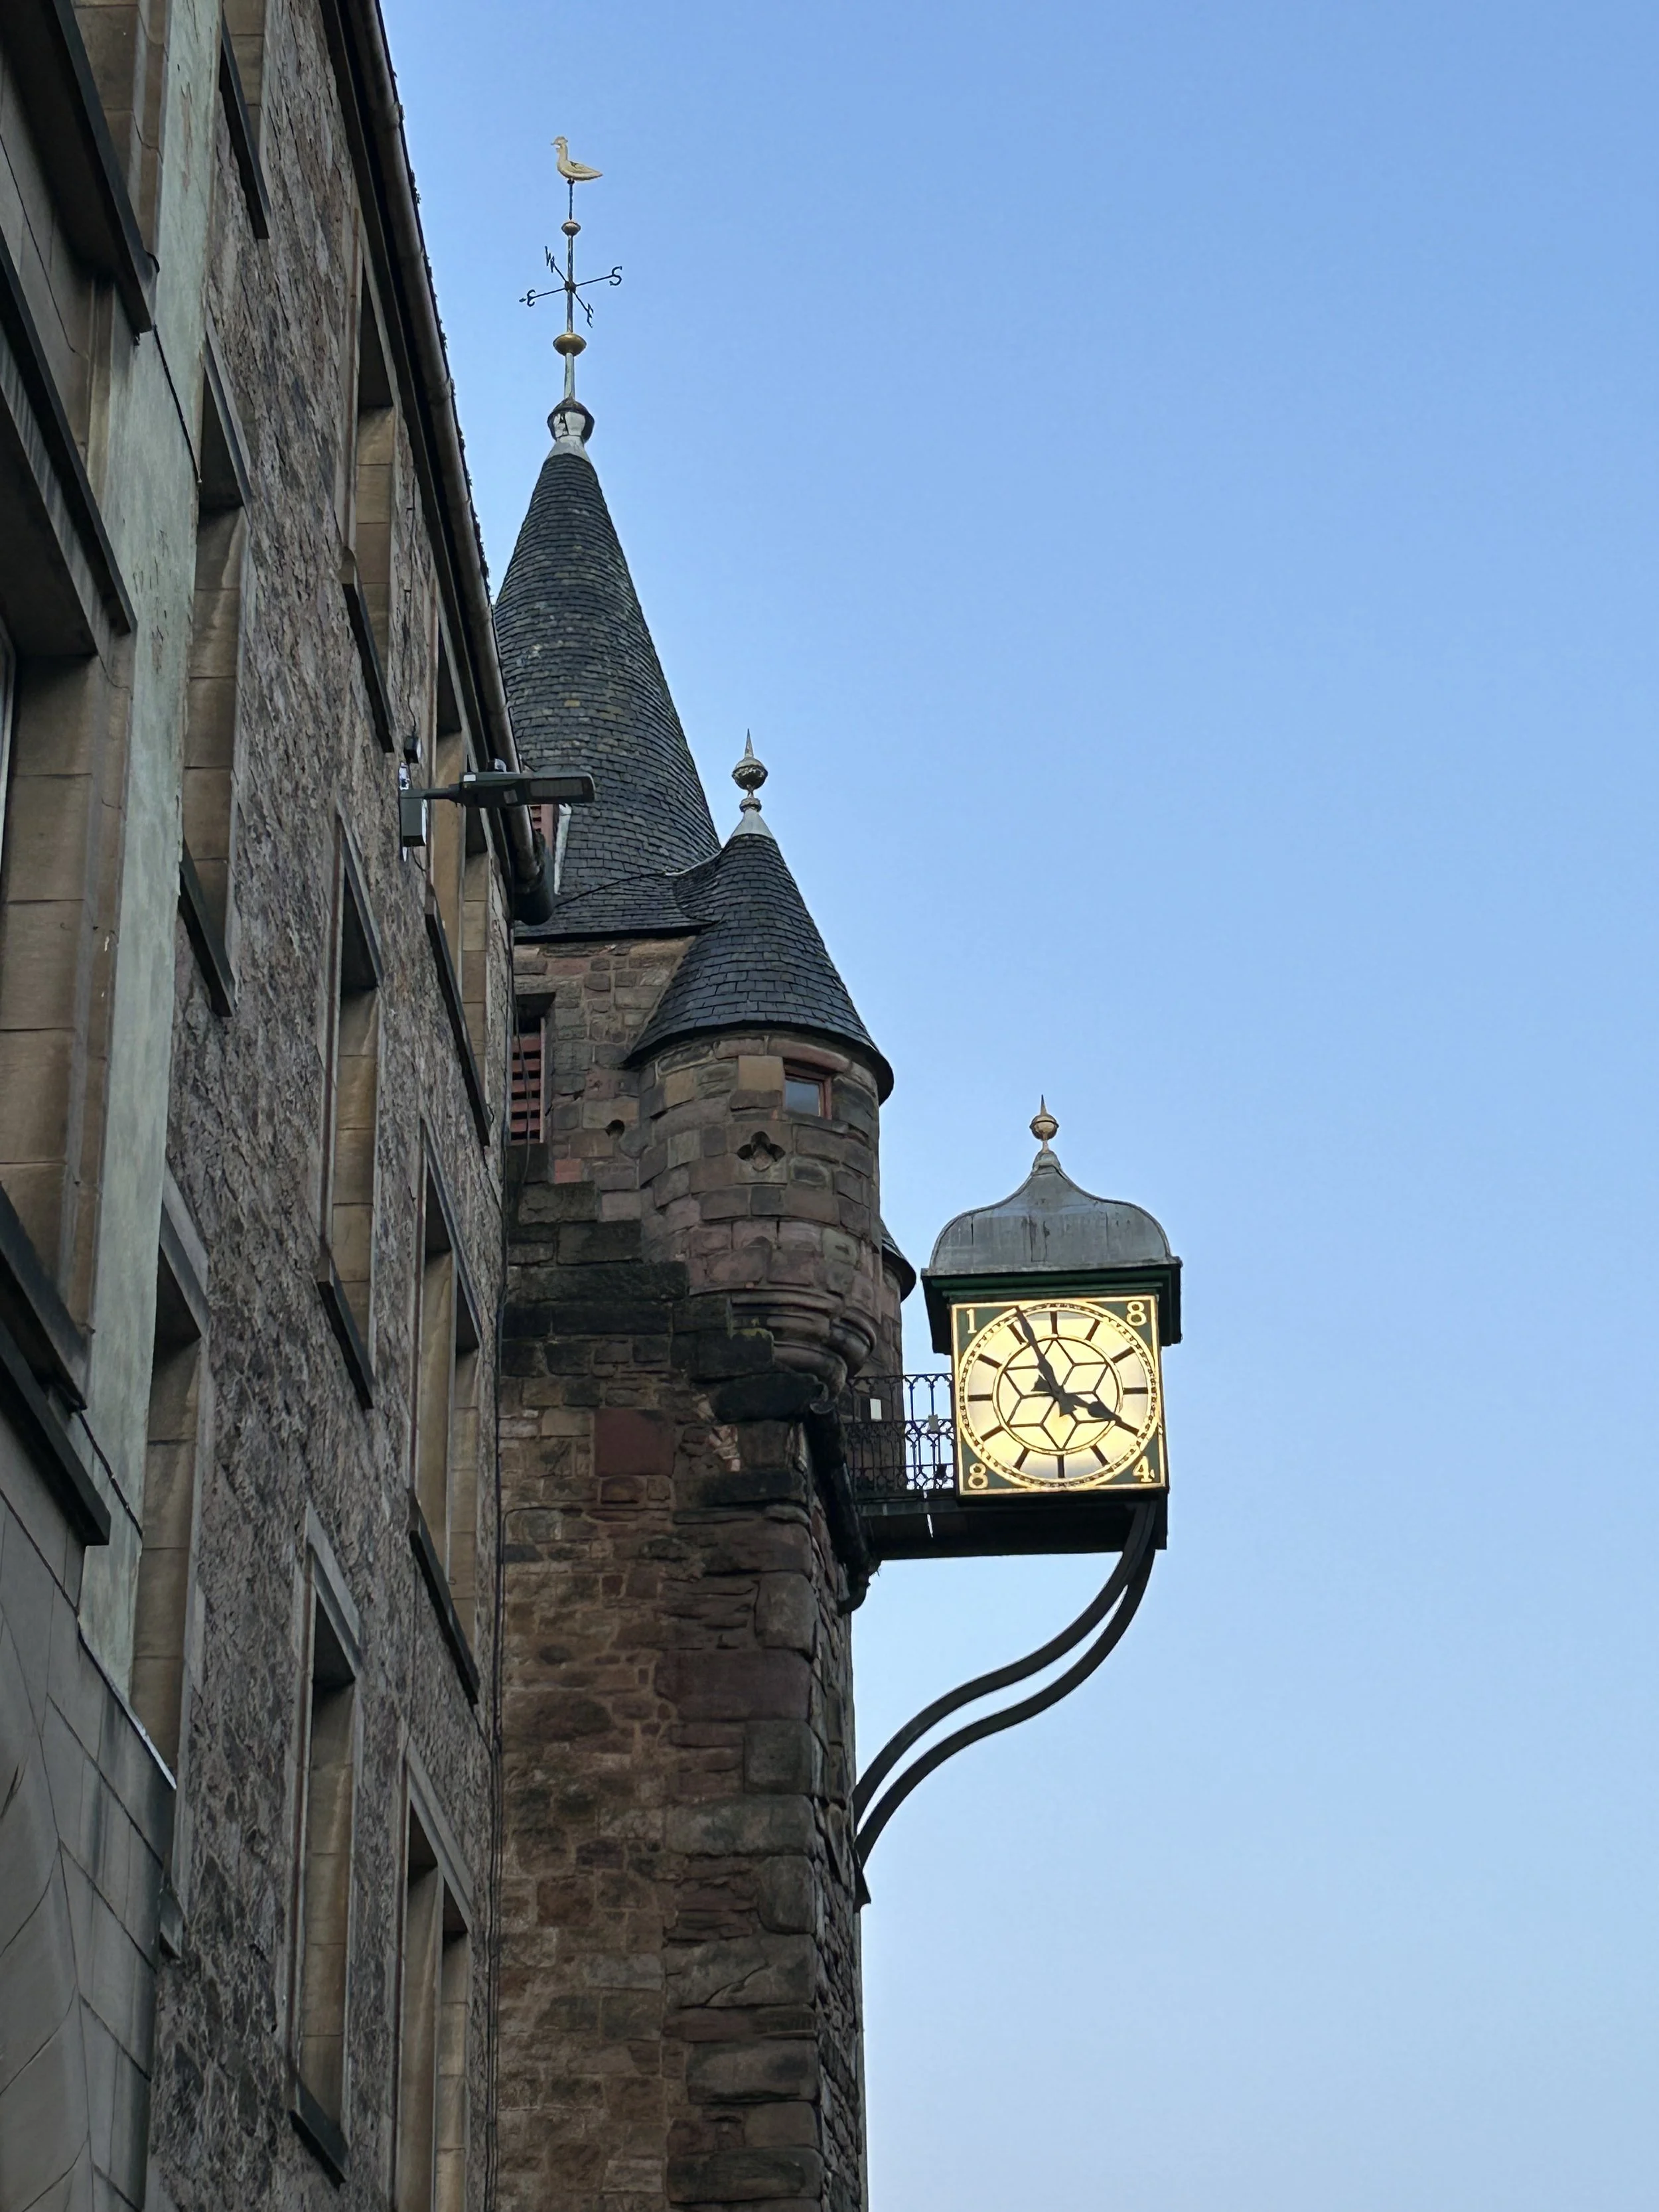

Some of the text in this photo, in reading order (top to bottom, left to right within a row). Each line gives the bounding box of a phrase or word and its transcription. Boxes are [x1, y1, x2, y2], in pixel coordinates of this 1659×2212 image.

[609, 265, 622, 286] S
[966, 1301, 1147, 1334] 1 8
[968, 1455, 1155, 1489] 8 4
